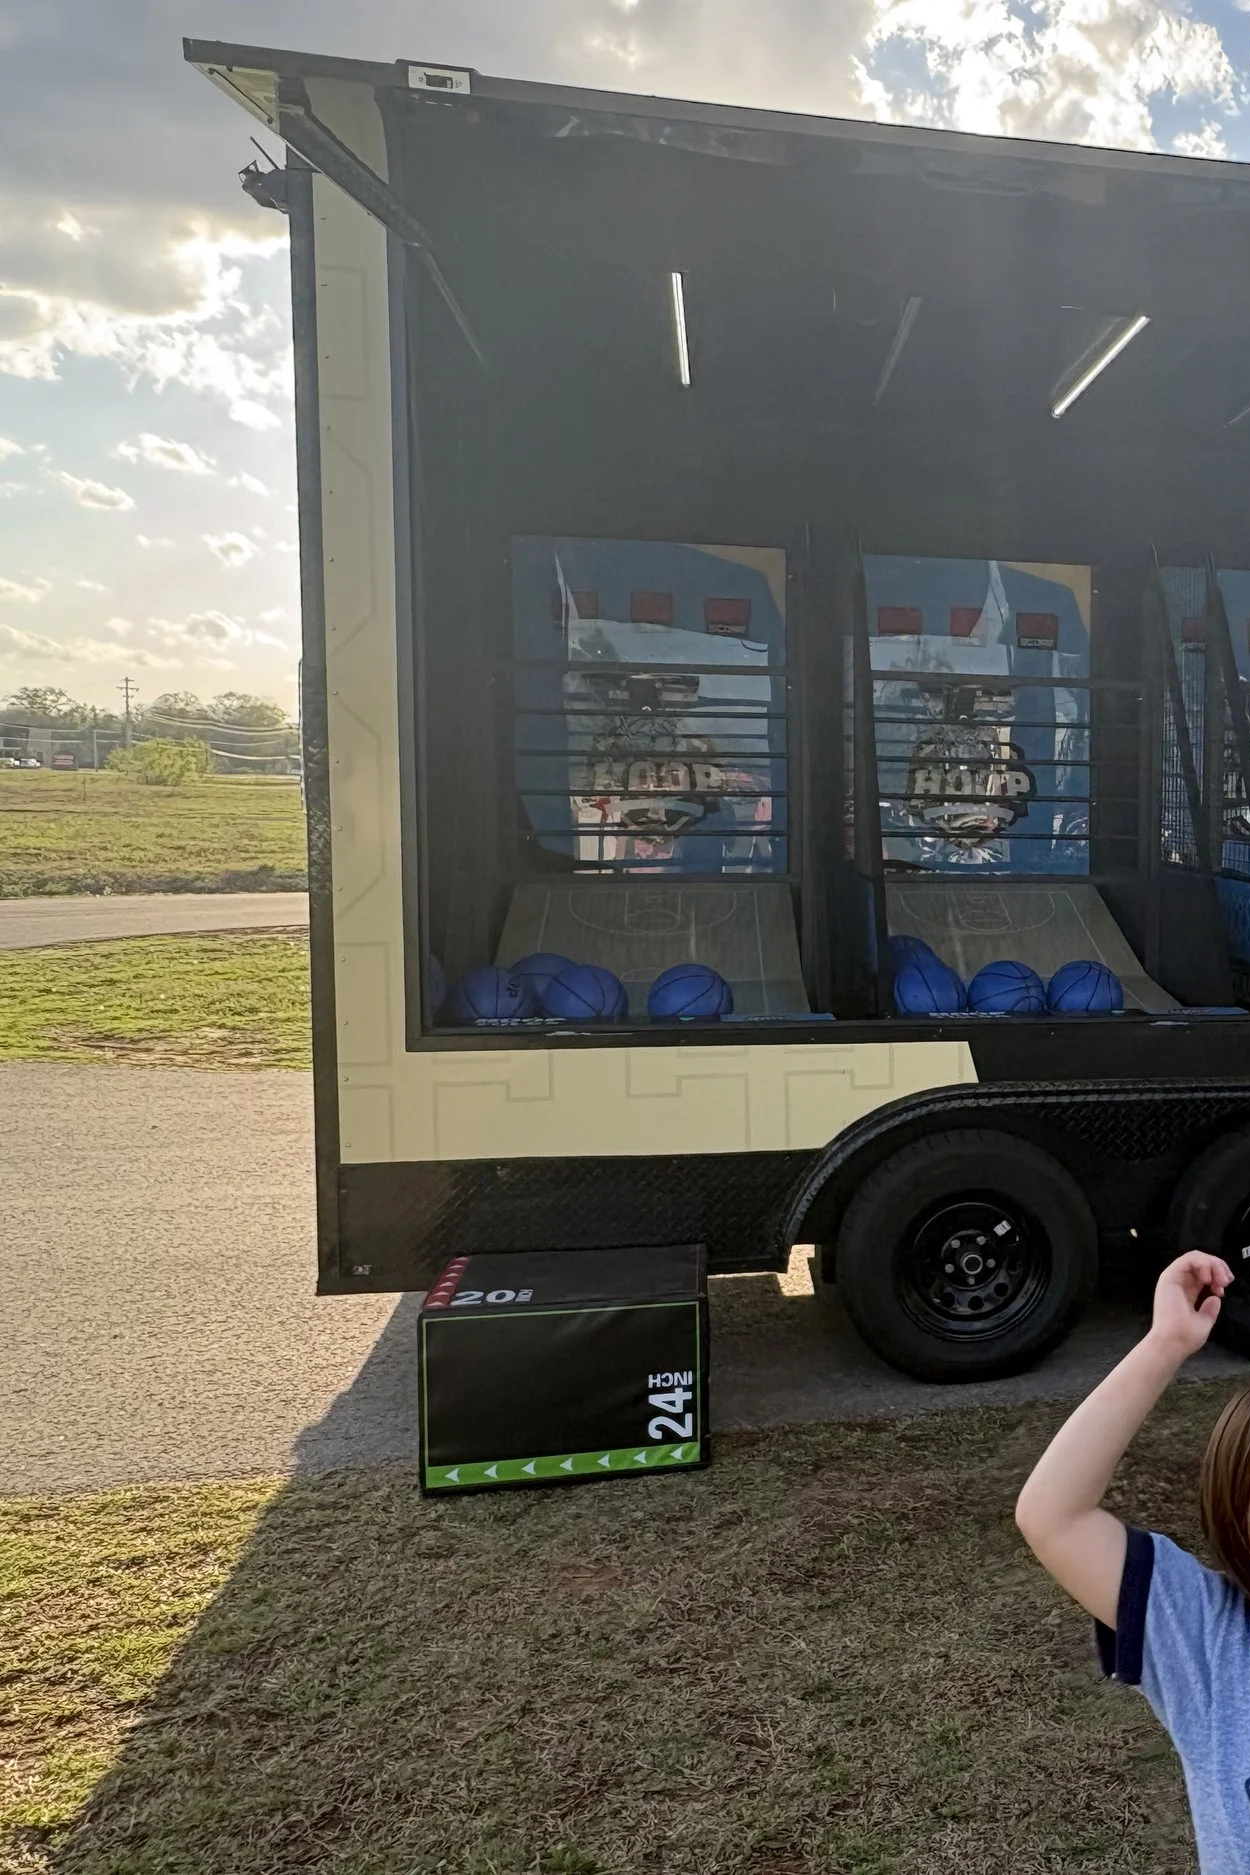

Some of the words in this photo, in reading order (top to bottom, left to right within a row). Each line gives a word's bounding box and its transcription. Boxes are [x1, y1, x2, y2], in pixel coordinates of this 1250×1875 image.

[451, 1290, 516, 1305] 20
[648, 1371, 693, 1388] INCH
[648, 1387, 693, 1440] 24
